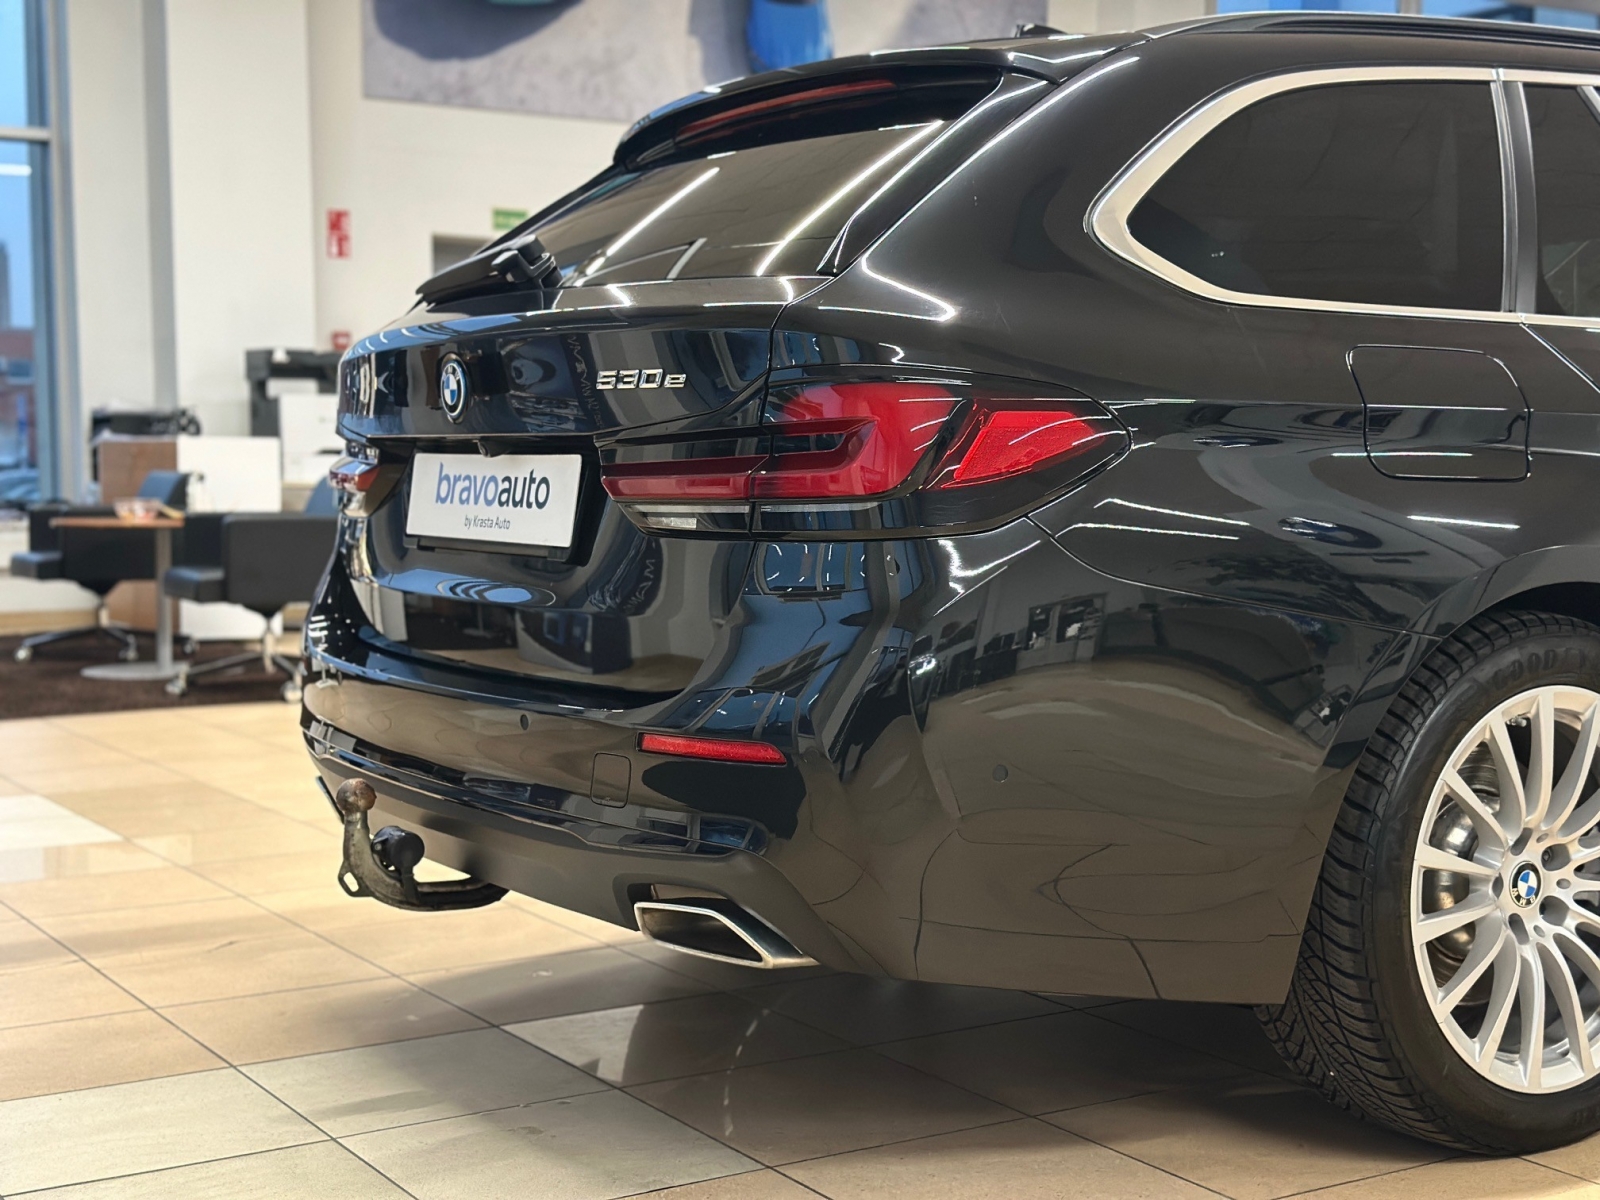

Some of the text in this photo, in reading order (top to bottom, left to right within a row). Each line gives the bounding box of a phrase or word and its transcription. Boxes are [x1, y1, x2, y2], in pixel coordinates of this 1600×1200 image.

[596, 368, 687, 390] 530e
[435, 462, 551, 510] bravoauto
[464, 514, 511, 530] by Krasta Auto
